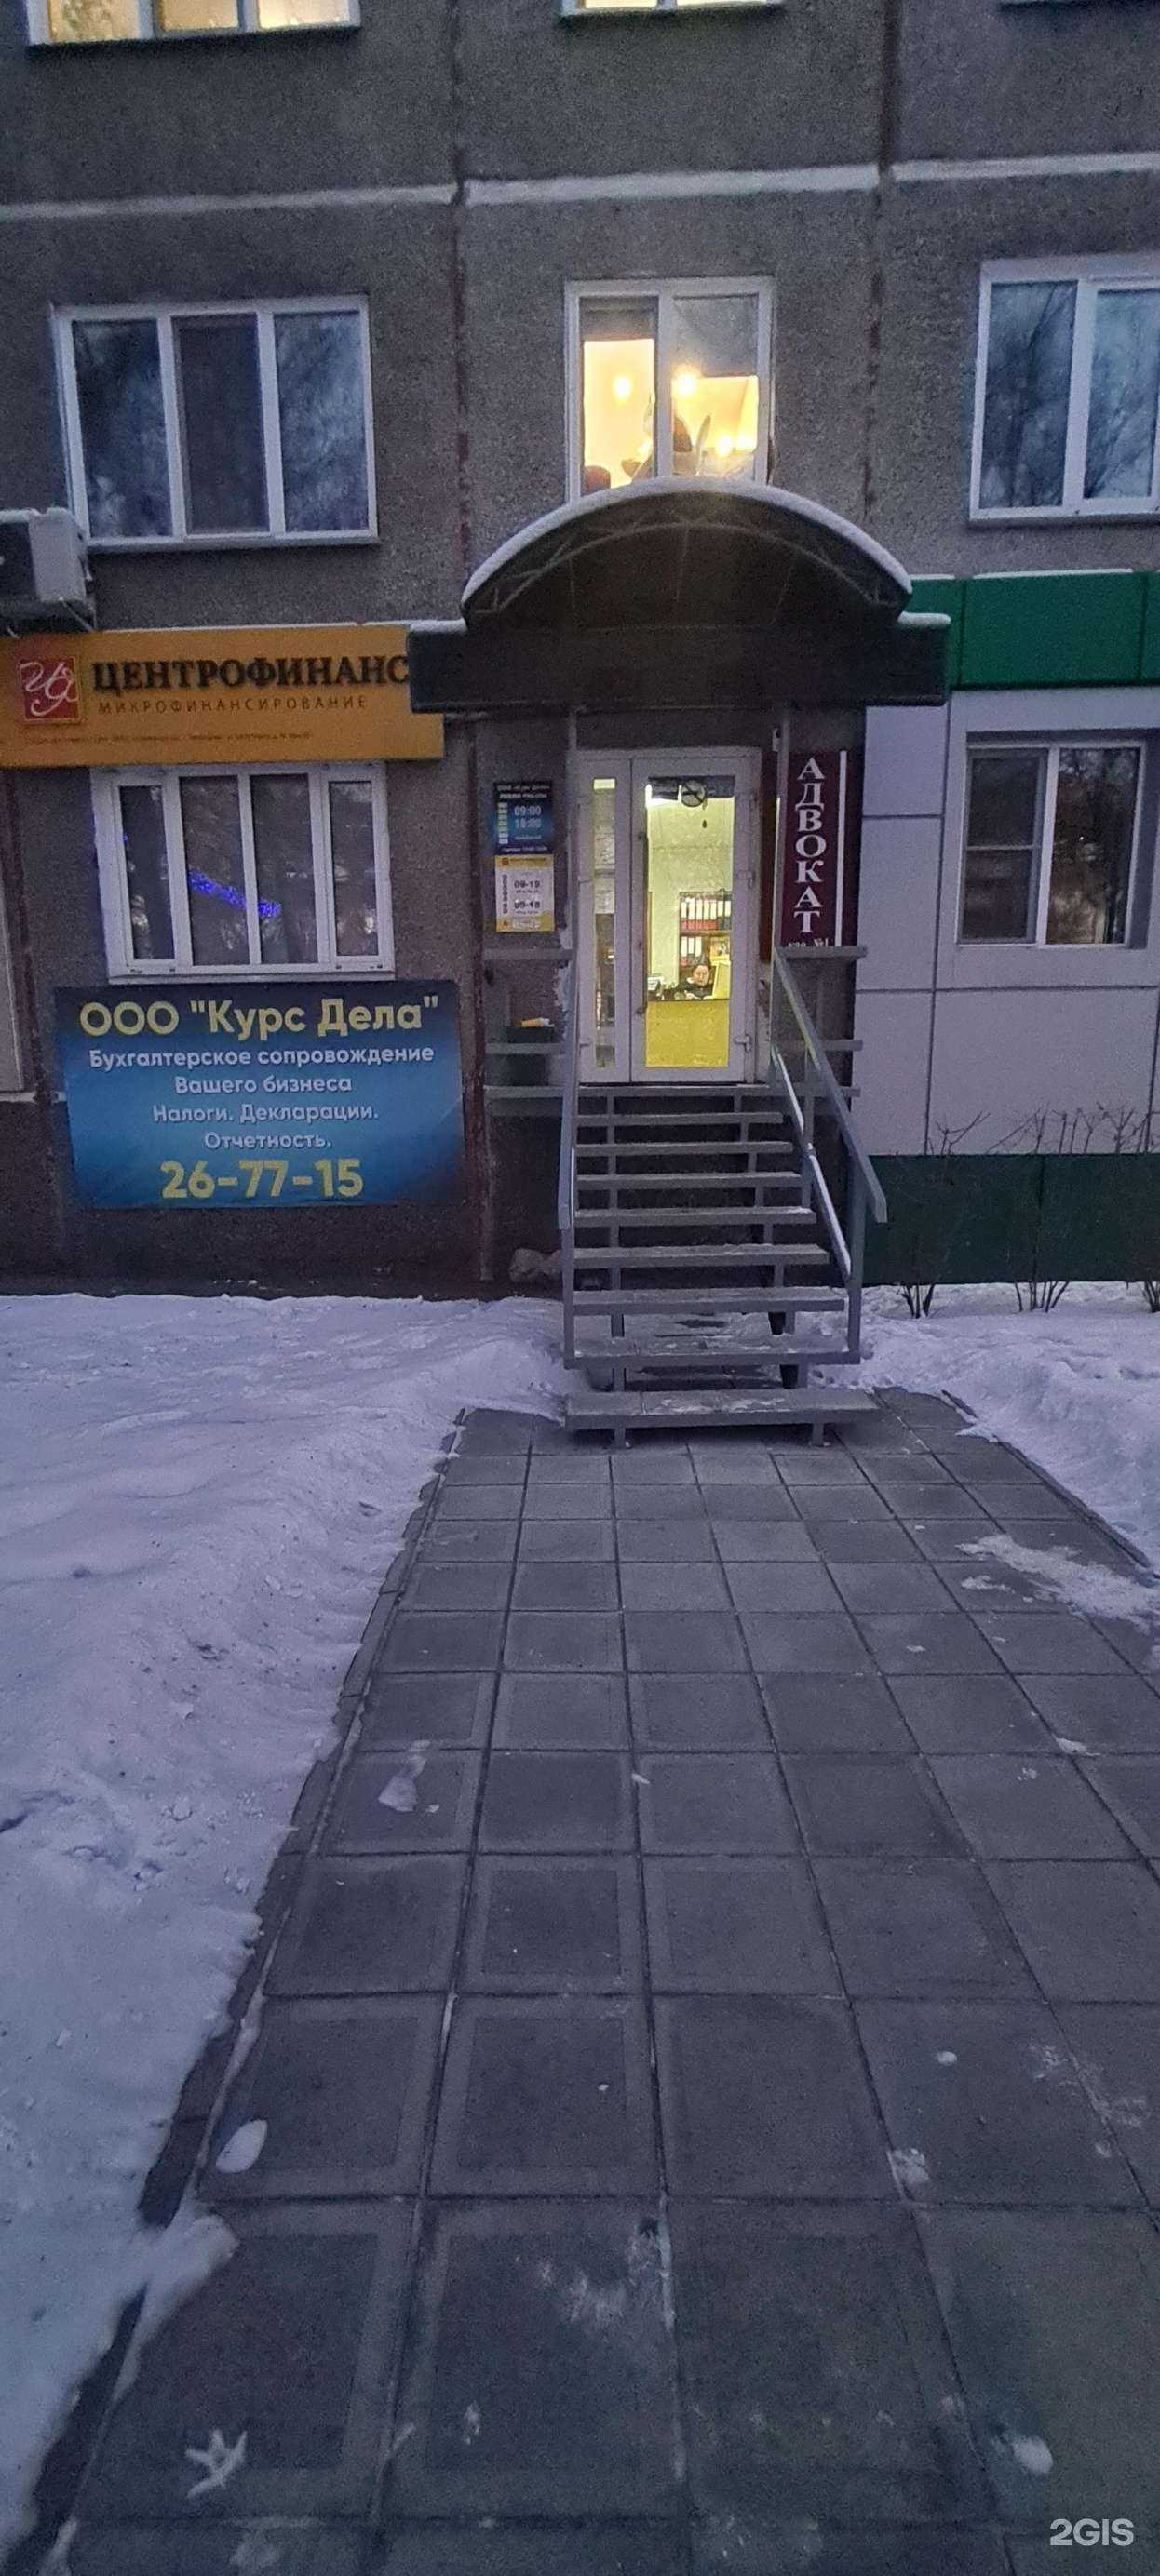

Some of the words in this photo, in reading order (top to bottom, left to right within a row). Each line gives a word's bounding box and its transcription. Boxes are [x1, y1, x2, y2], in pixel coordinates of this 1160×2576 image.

[92, 655, 409, 696] ЦЕНТРОФИНАНС
[98, 695, 366, 714] МИКРОФИНАНСИРОВАНИЕ
[793, 757, 827, 932] АДВОКАТ
[79, 1001, 179, 1036] ООО
[190, 1000, 305, 1041] "Курс
[317, 996, 438, 1038] Дела"
[89, 1049, 251, 1071] Бухгалтерское
[257, 1046, 435, 1067] сопровождение
[174, 1076, 257, 1093] Вашего
[263, 1074, 352, 1093] бизнеса
[153, 1104, 234, 1122] Налоги.
[239, 1103, 379, 1124] Декларации.
[204, 1131, 332, 1150] Отчетность.
[160, 1158, 364, 1199] 26-77-15
